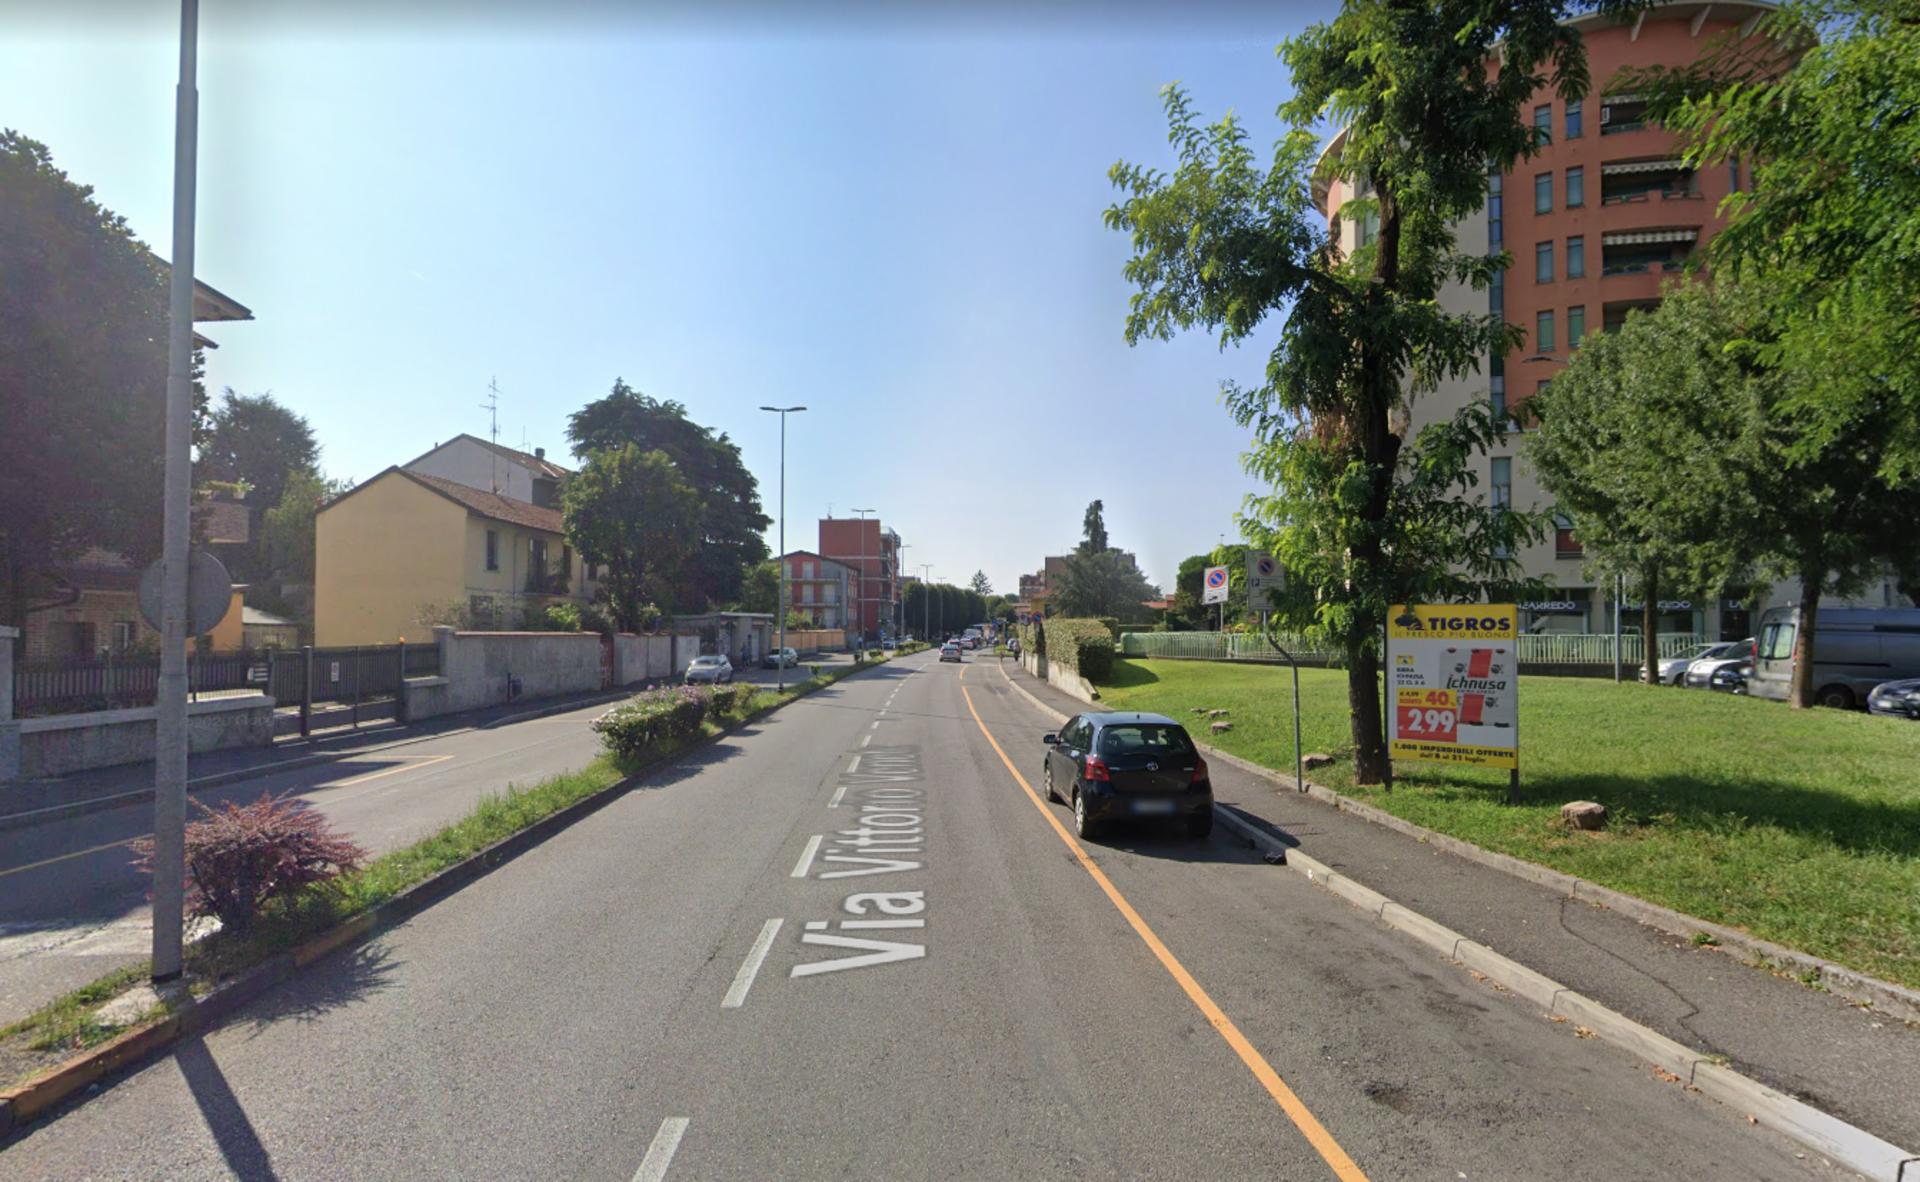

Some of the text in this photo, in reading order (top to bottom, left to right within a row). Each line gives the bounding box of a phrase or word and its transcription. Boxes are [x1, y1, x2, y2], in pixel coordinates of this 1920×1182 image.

[1428, 617, 1511, 631] TIGROS
[1408, 708, 1455, 734] 2,99
[1420, 745, 1474, 755] IMPERDIBILI
[1476, 749, 1514, 758] OFFERTE
[1465, 755, 1486, 764] luglio
